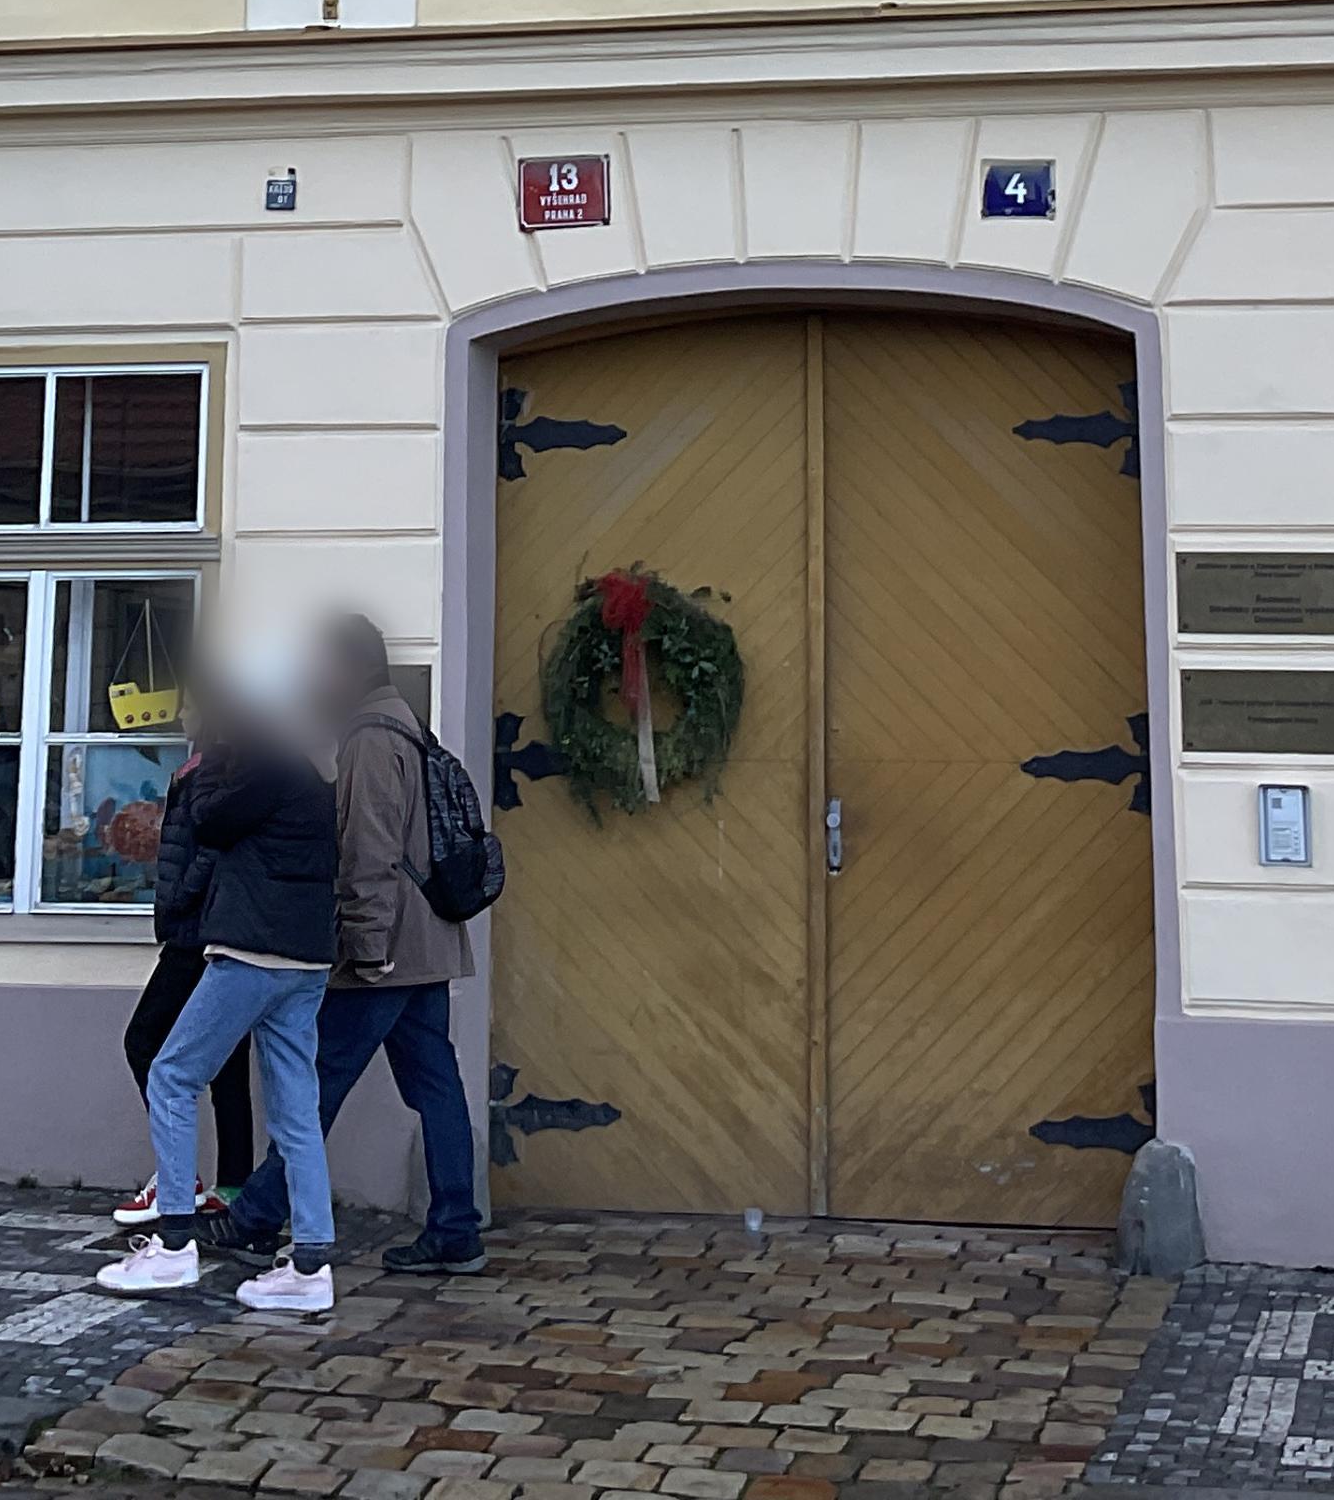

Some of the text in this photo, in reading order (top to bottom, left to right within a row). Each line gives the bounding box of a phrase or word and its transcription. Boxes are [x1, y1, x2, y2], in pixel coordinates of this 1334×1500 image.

[549, 163, 579, 192] 13
[1004, 172, 1027, 204] 4
[539, 192, 587, 206] VYŠEHRAD
[544, 208, 583, 220] PRAHA 2
